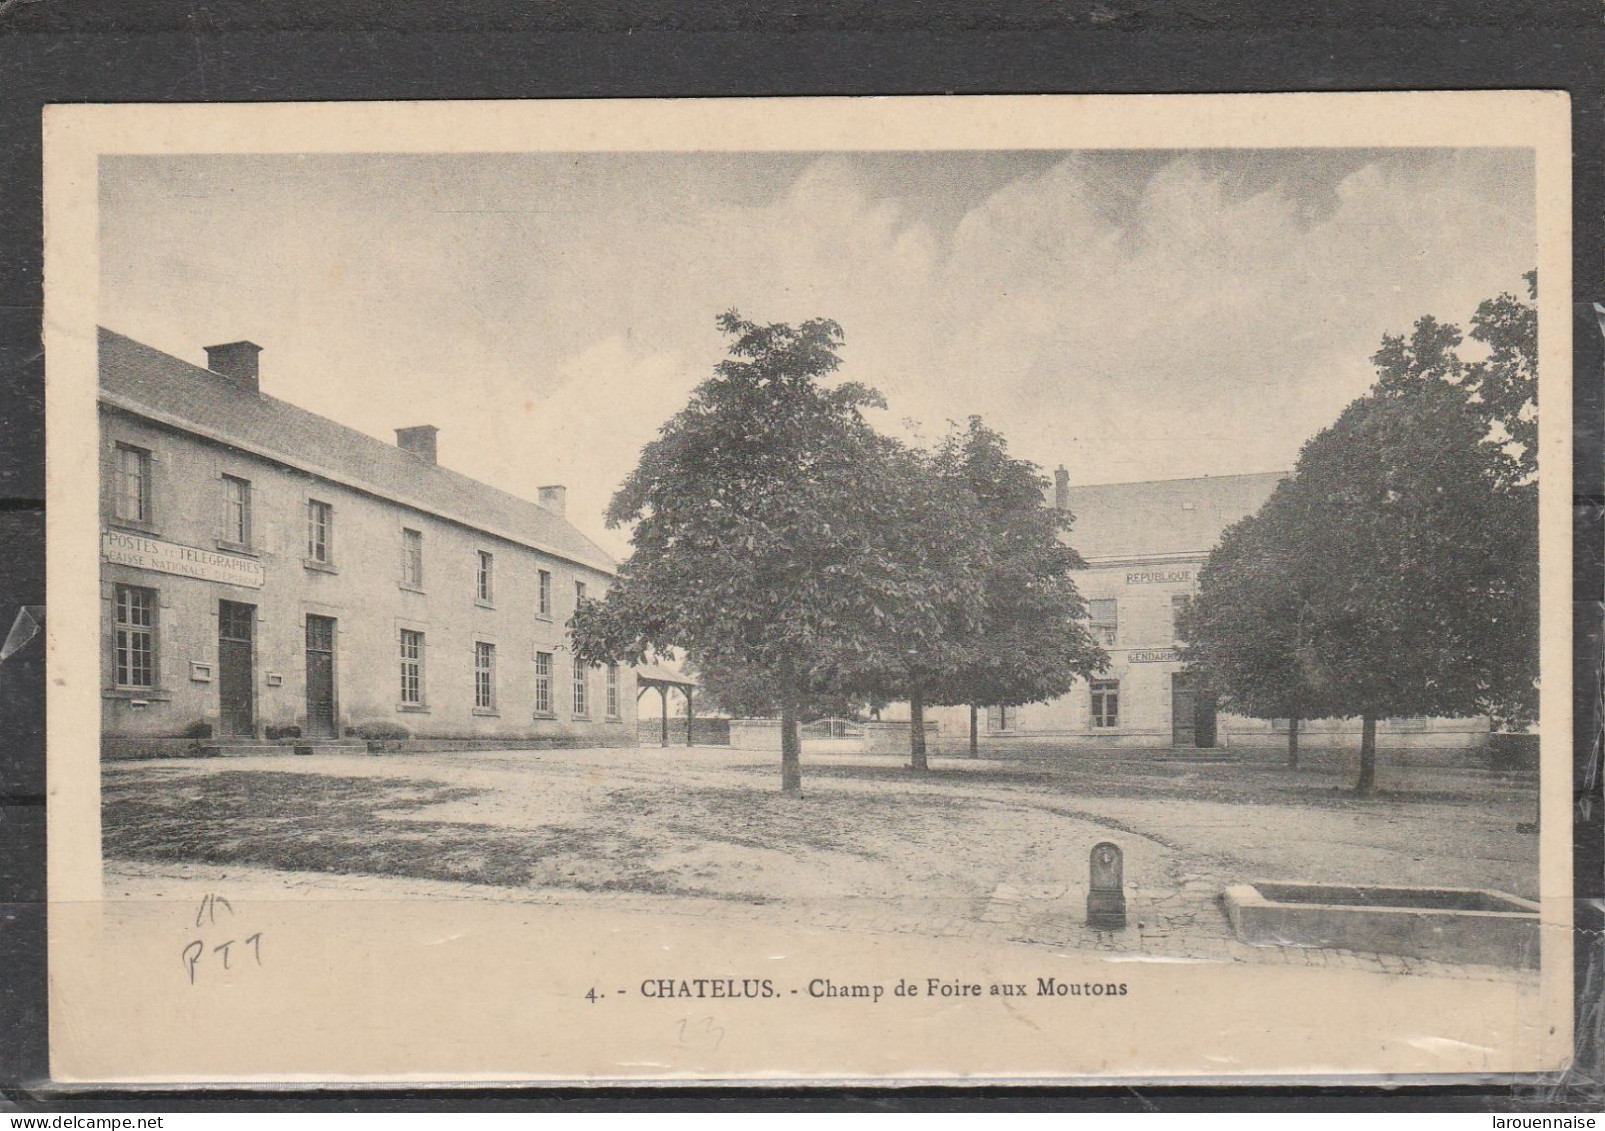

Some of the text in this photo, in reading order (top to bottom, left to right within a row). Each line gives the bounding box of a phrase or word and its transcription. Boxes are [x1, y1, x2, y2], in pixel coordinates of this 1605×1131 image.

[109, 532, 158, 554] POSTES
[109, 550, 145, 565] CAISSE
[151, 558, 206, 577] NATIONALE
[585, 987, 605, 1003] 4.
[641, 979, 781, 998] CHATELUS.
[808, 979, 884, 1002] Champ
[894, 979, 918, 996] de
[927, 978, 982, 996] Foire
[990, 982, 1027, 996] aux
[1037, 978, 1128, 996] Moutons
